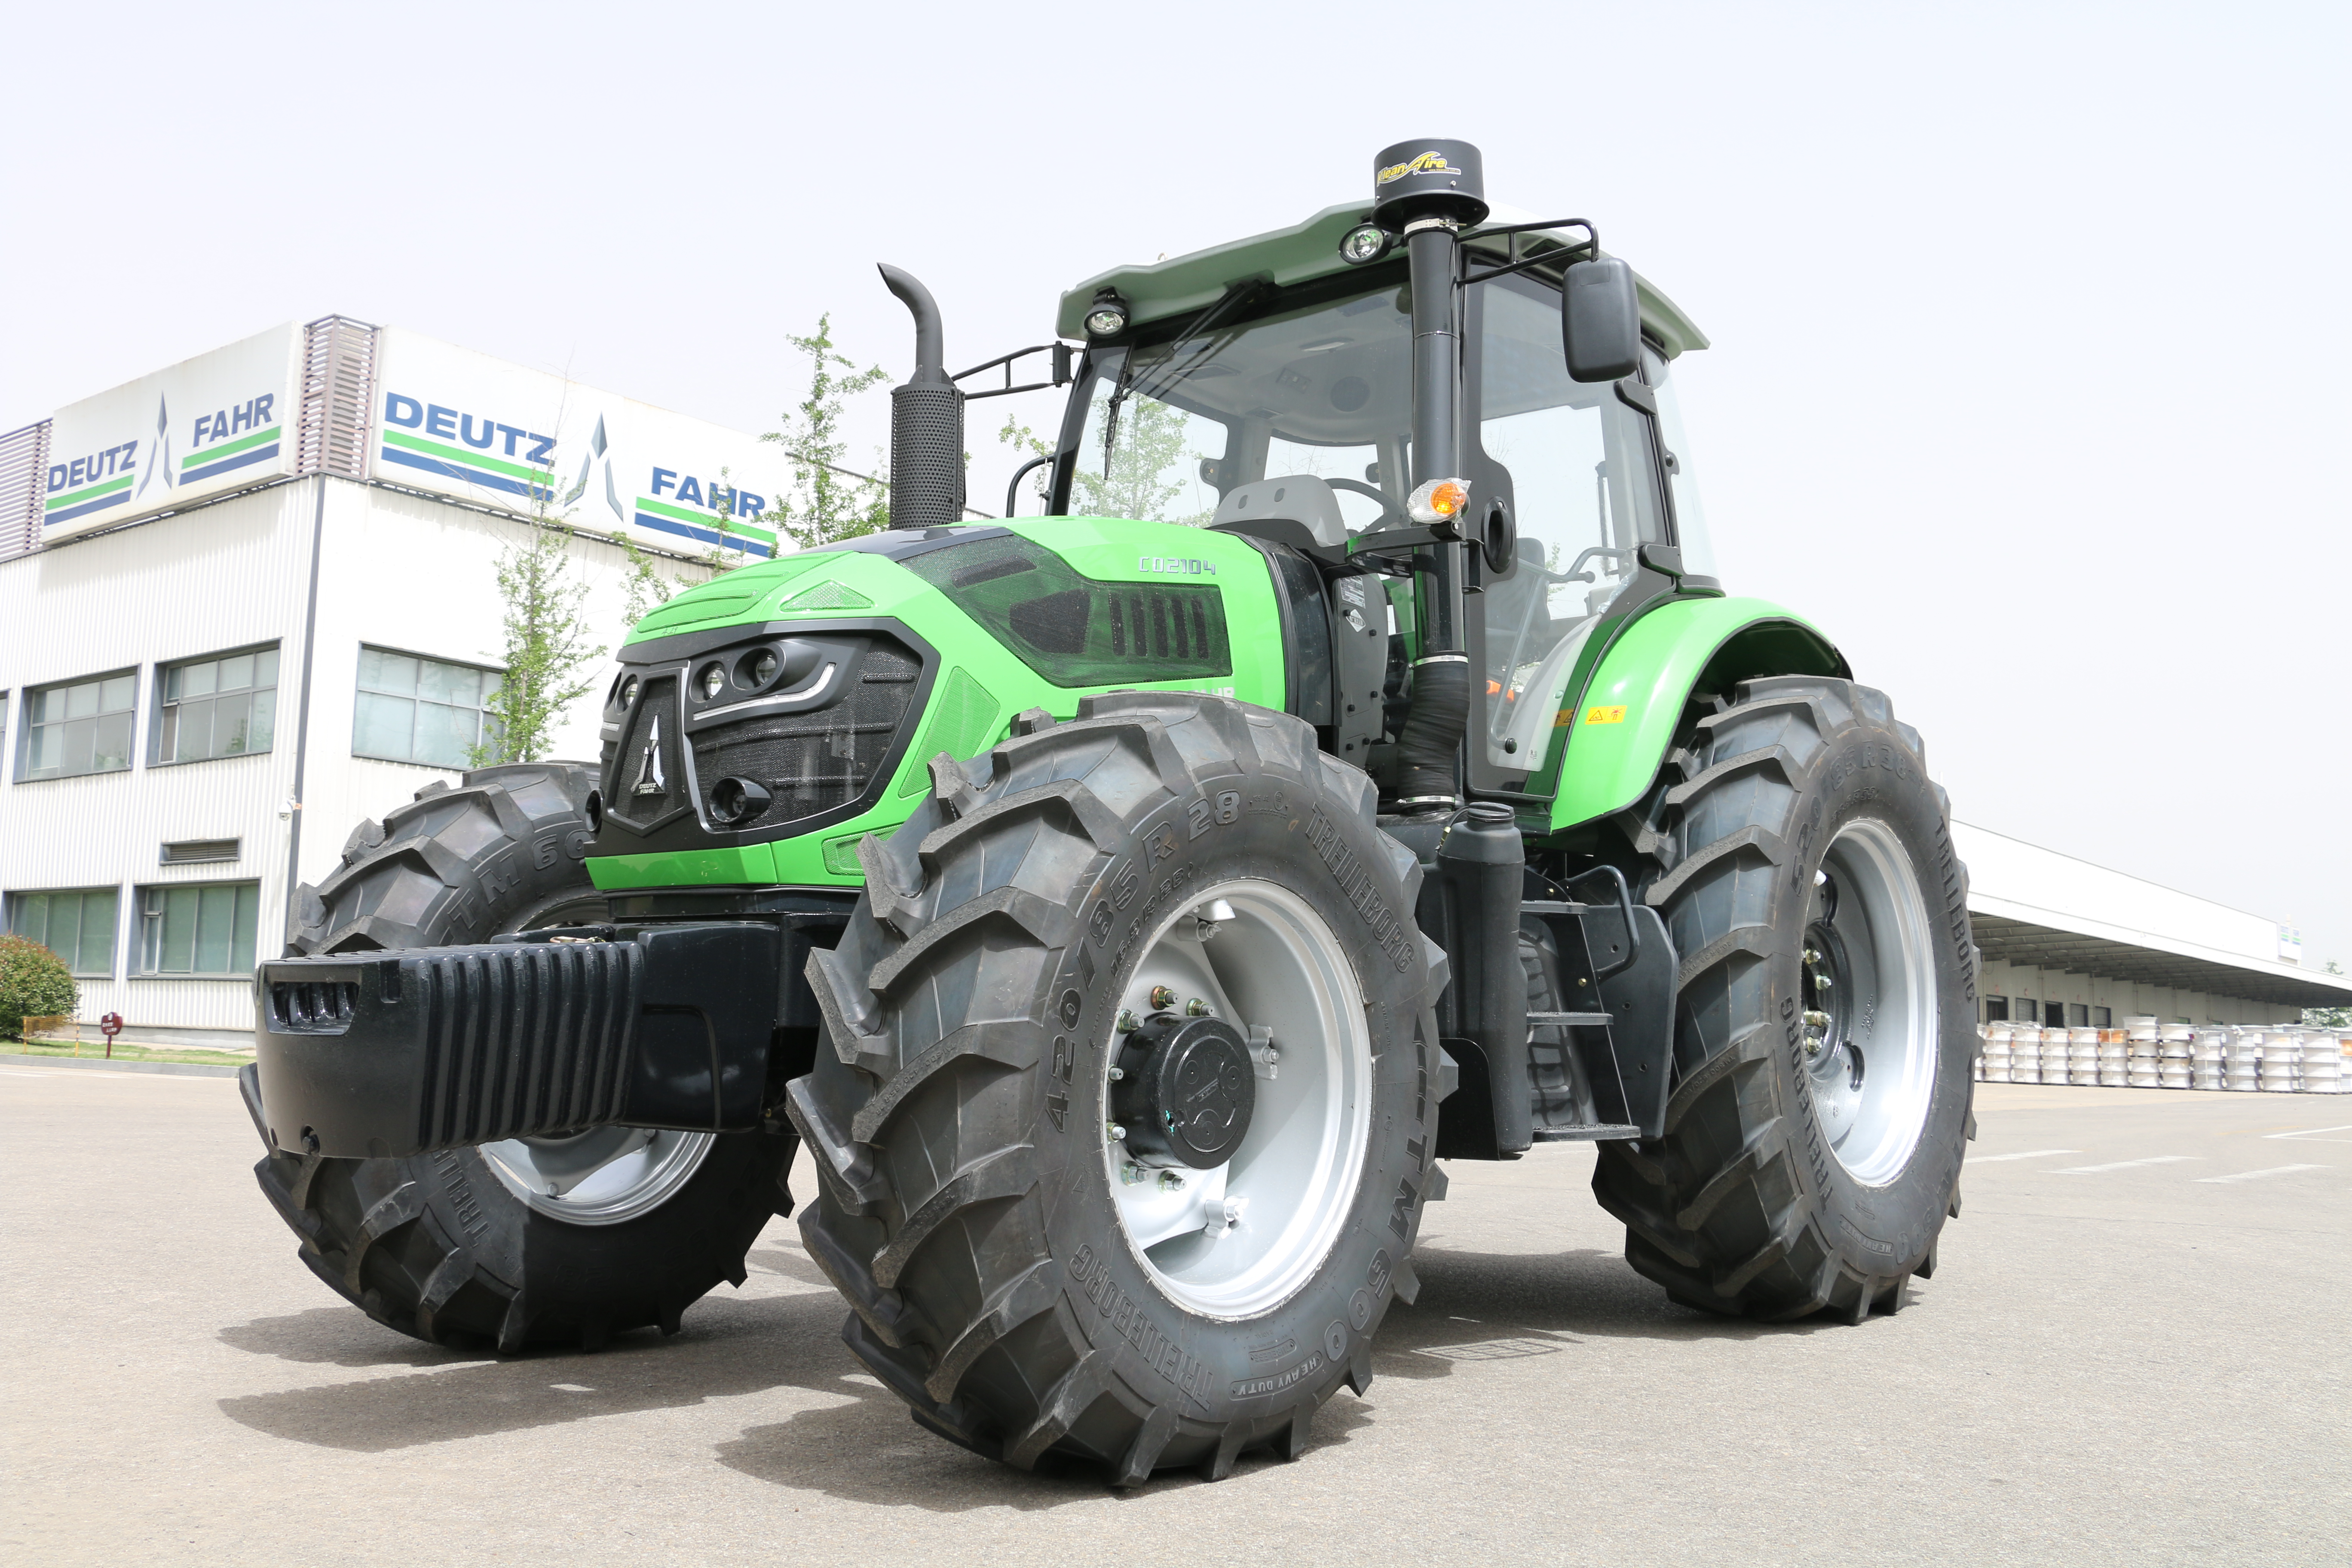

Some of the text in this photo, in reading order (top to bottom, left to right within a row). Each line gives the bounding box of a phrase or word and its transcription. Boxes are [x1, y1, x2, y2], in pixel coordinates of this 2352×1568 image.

[47, 393, 274, 493] DEUTZ FAHR
[385, 391, 766, 518] DEUTZ FAHR
[1142, 821, 1176, 874] R
[1188, 789, 1241, 842] 28
[1304, 800, 1415, 974] TRELLEBORG
[1935, 815, 1974, 1003] TRELLEBORG
[1779, 995, 1834, 1215] TRELLEBORG
[1069, 1242, 1214, 1413] TRELLEBORG
[1323, 1247, 1393, 1364] 600
[1237, 1357, 1317, 1396] HEAVY DUTY
